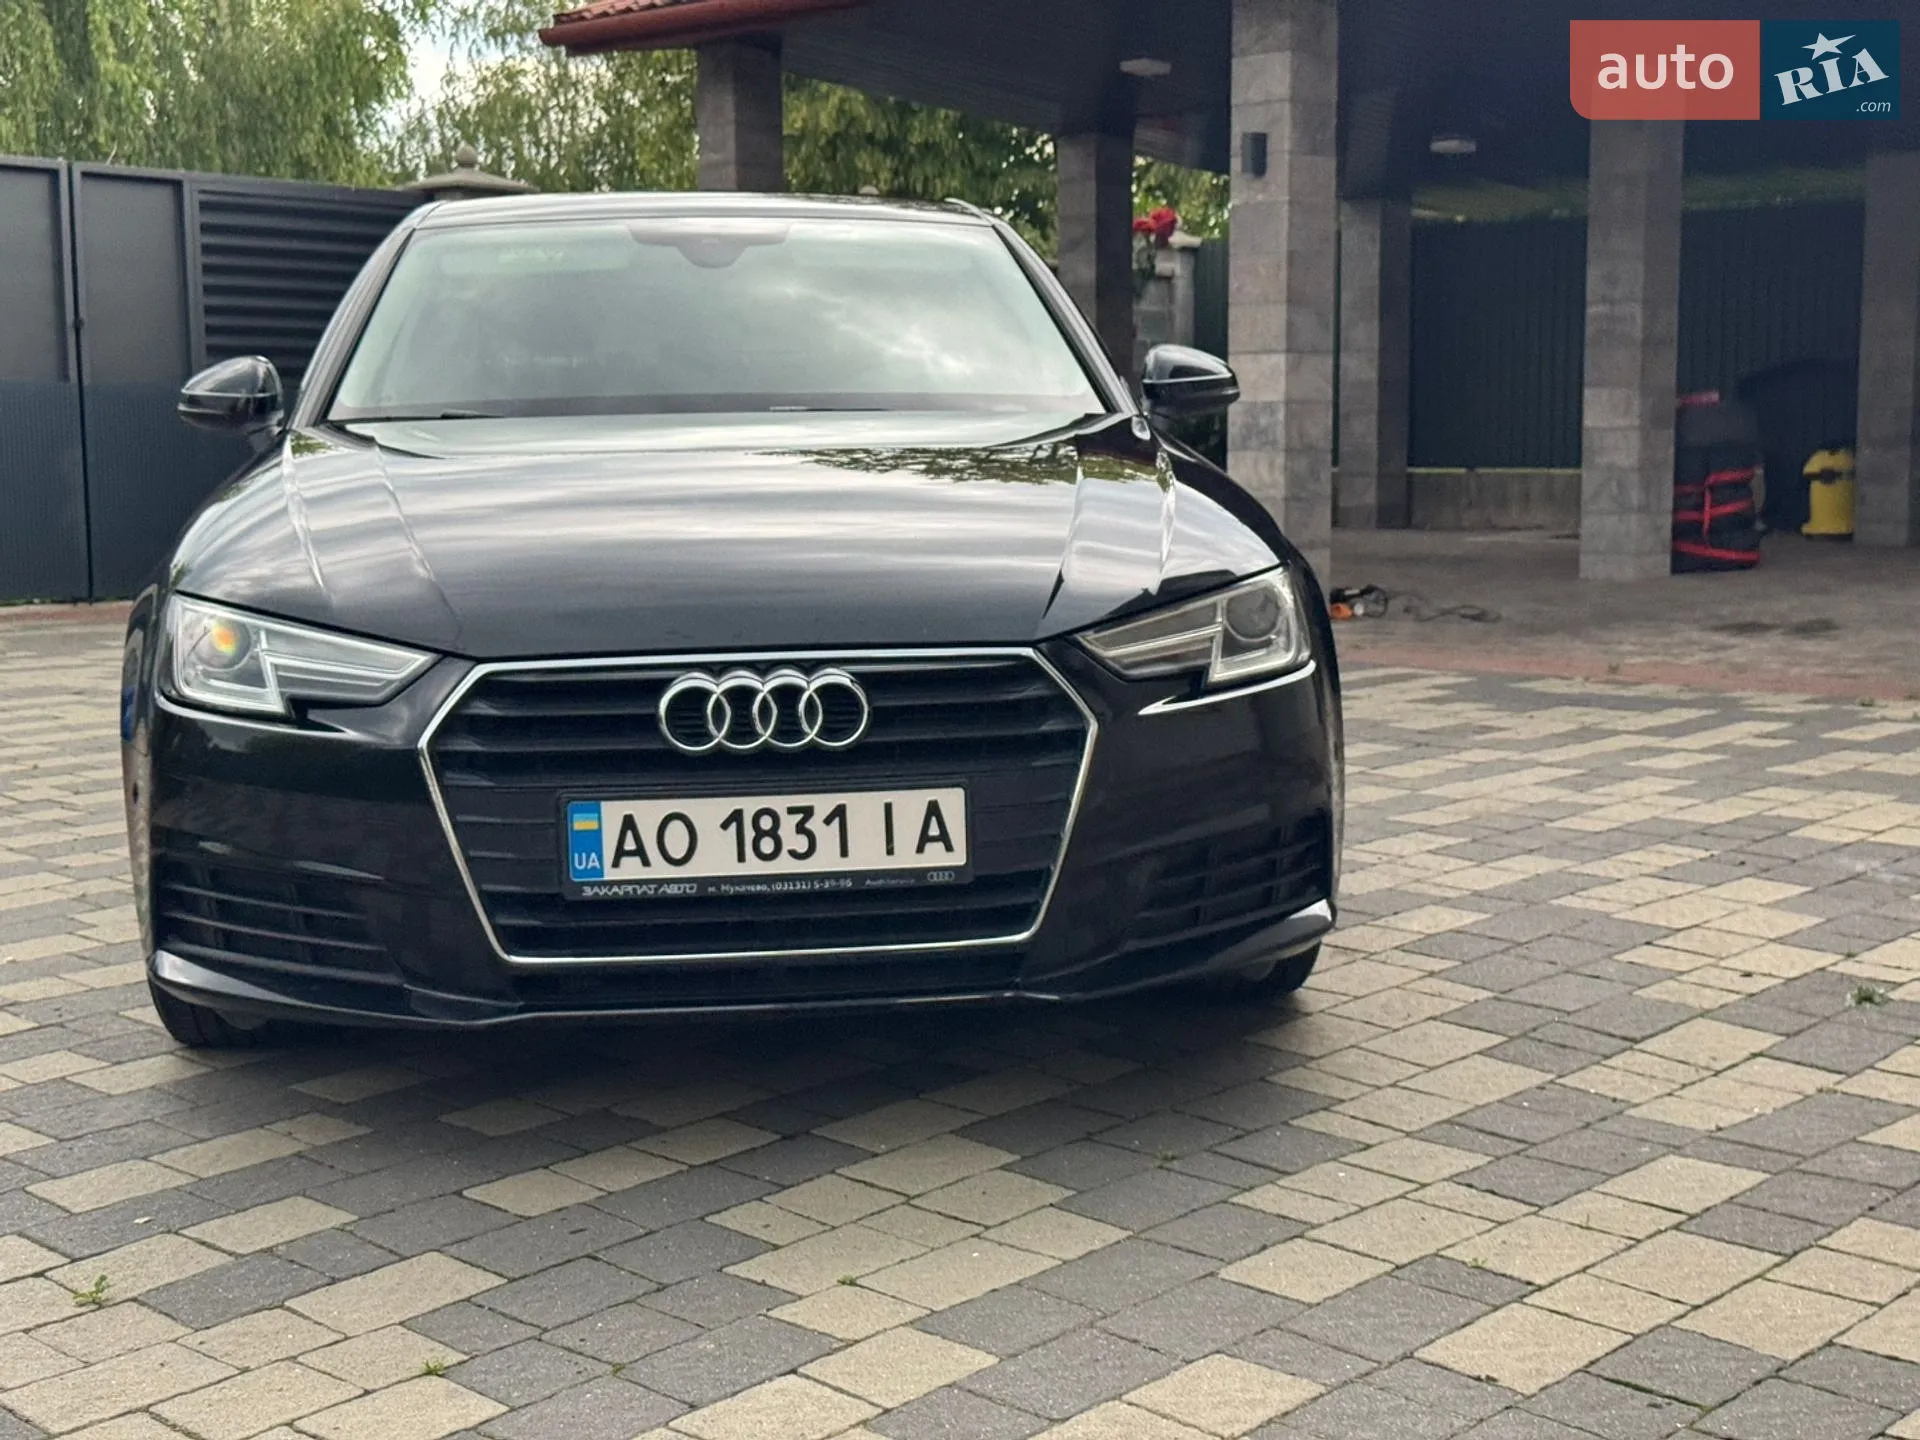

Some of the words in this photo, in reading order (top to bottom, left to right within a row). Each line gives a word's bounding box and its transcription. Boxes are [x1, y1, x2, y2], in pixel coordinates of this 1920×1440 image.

[611, 812, 699, 868] AO
[719, 803, 850, 864] 1831
[883, 799, 955, 857] IA
[574, 852, 601, 871] UA
